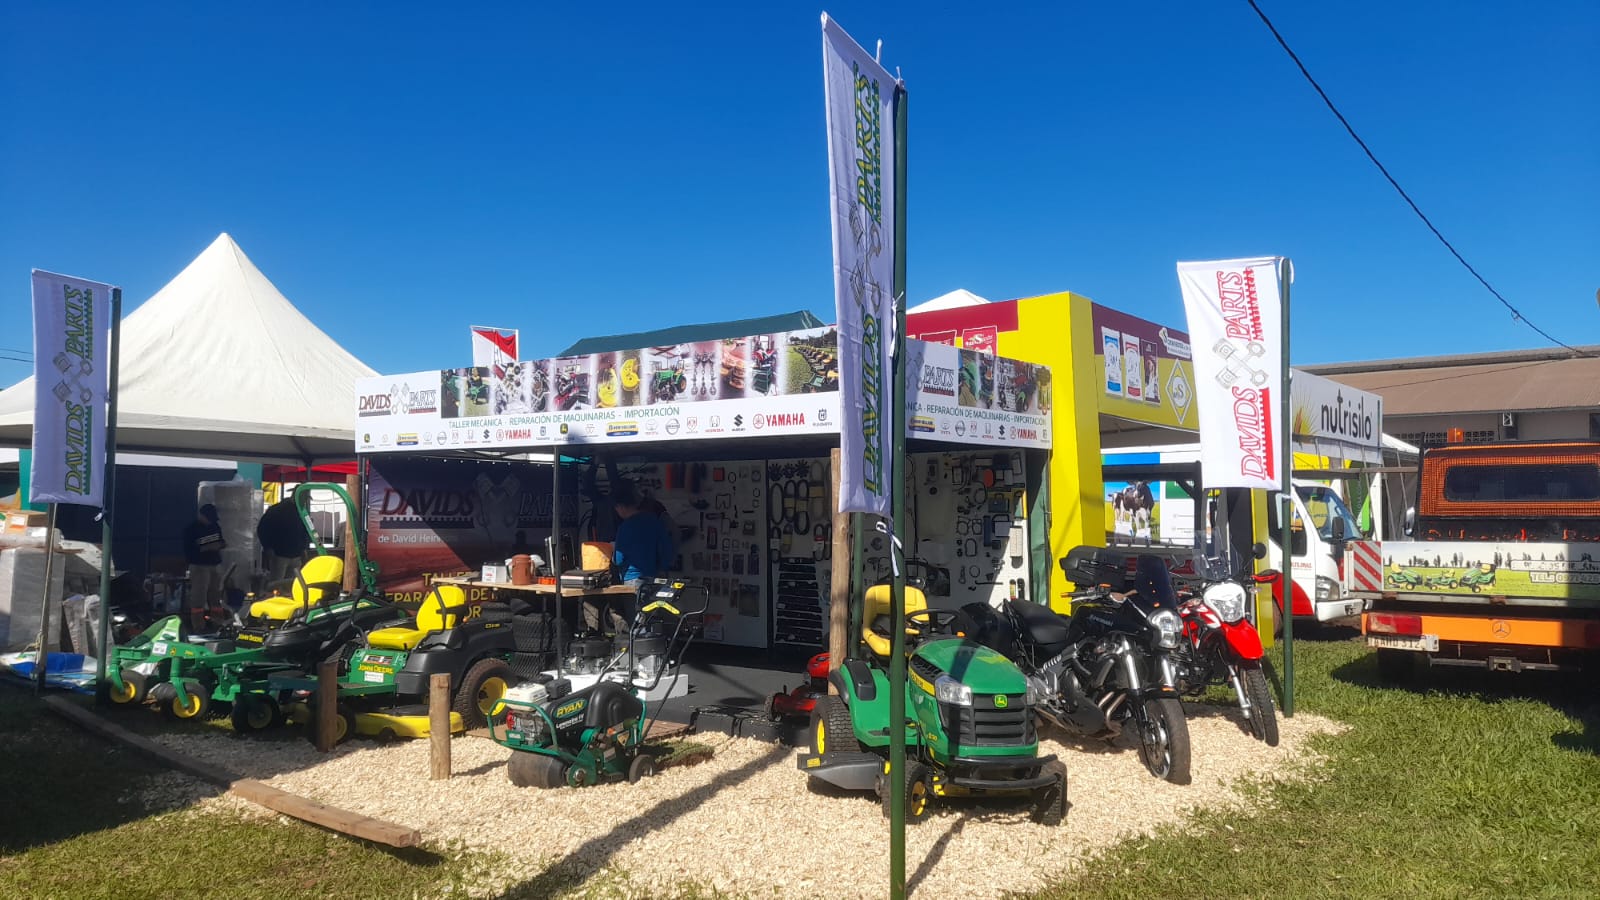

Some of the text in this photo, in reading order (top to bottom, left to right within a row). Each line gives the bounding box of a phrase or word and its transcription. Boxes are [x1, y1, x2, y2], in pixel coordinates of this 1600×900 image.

[854, 61, 873, 222] PARTS
[1217, 271, 1252, 341] PARTS
[64, 284, 85, 358] PARTS
[923, 364, 954, 388] PARTS
[359, 393, 391, 411] DAVIDS
[862, 304, 877, 498] DAVIDS
[449, 420, 470, 429] TALLER
[509, 414, 551, 425] REPARACIÓN
[553, 413, 562, 423] DE
[564, 410, 615, 422] MAQUINARIAS
[624, 406, 680, 418] IMPORTACIÓN
[766, 412, 805, 427] YAMAHA
[926, 404, 963, 417] REPARACIÓN
[965, 409, 973, 418] DE
[973, 410, 1011, 422] MAQUINARIAS
[1321, 388, 1372, 440] nutrisilo
[505, 428, 532, 440] YAMAHA
[1017, 428, 1038, 440] YAMAHA
[1232, 386, 1266, 480] DAVIDS
[65, 400, 86, 496] DAVIDS
[379, 487, 475, 516] DAVIDS
[378, 533, 390, 544] de
[392, 533, 417, 544] David
[471, 588, 489, 601] DE
[373, 665, 394, 674] DEERE
[556, 700, 583, 717] RYAN
